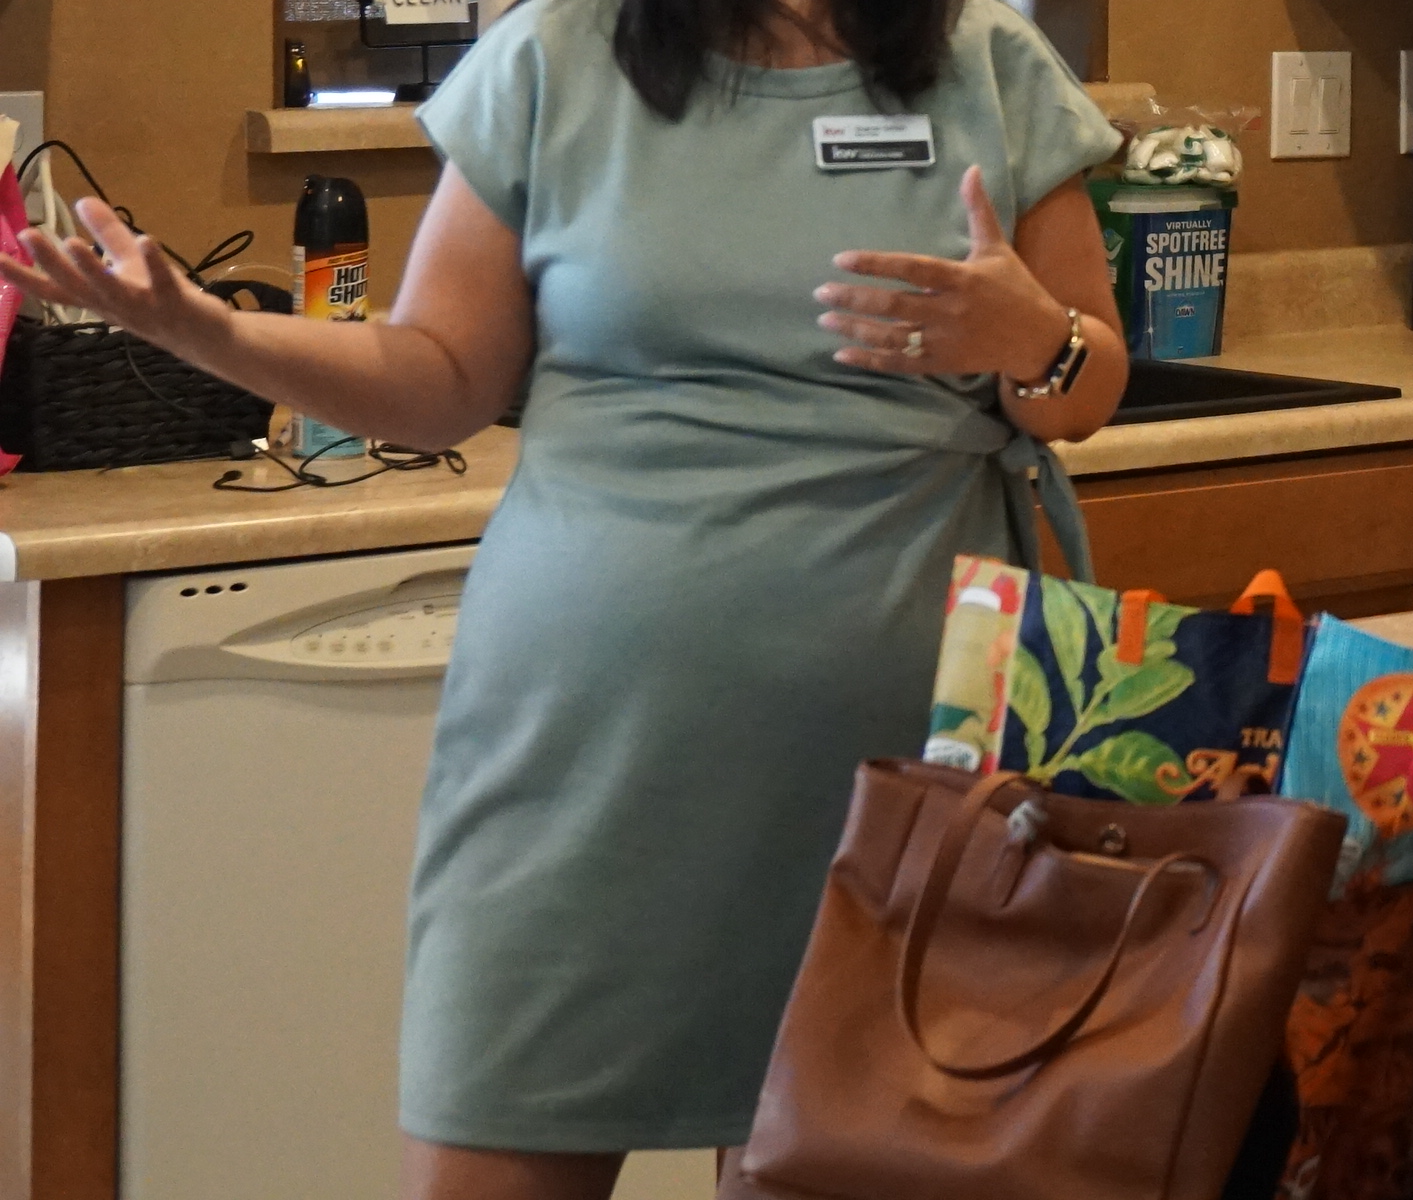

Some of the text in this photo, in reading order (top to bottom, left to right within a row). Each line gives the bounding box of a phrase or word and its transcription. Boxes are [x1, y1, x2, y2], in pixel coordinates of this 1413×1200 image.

[1166, 219, 1212, 230] VIRTUALLY
[1145, 229, 1226, 254] SPOTFREE
[1144, 253, 1225, 291] SHINE
